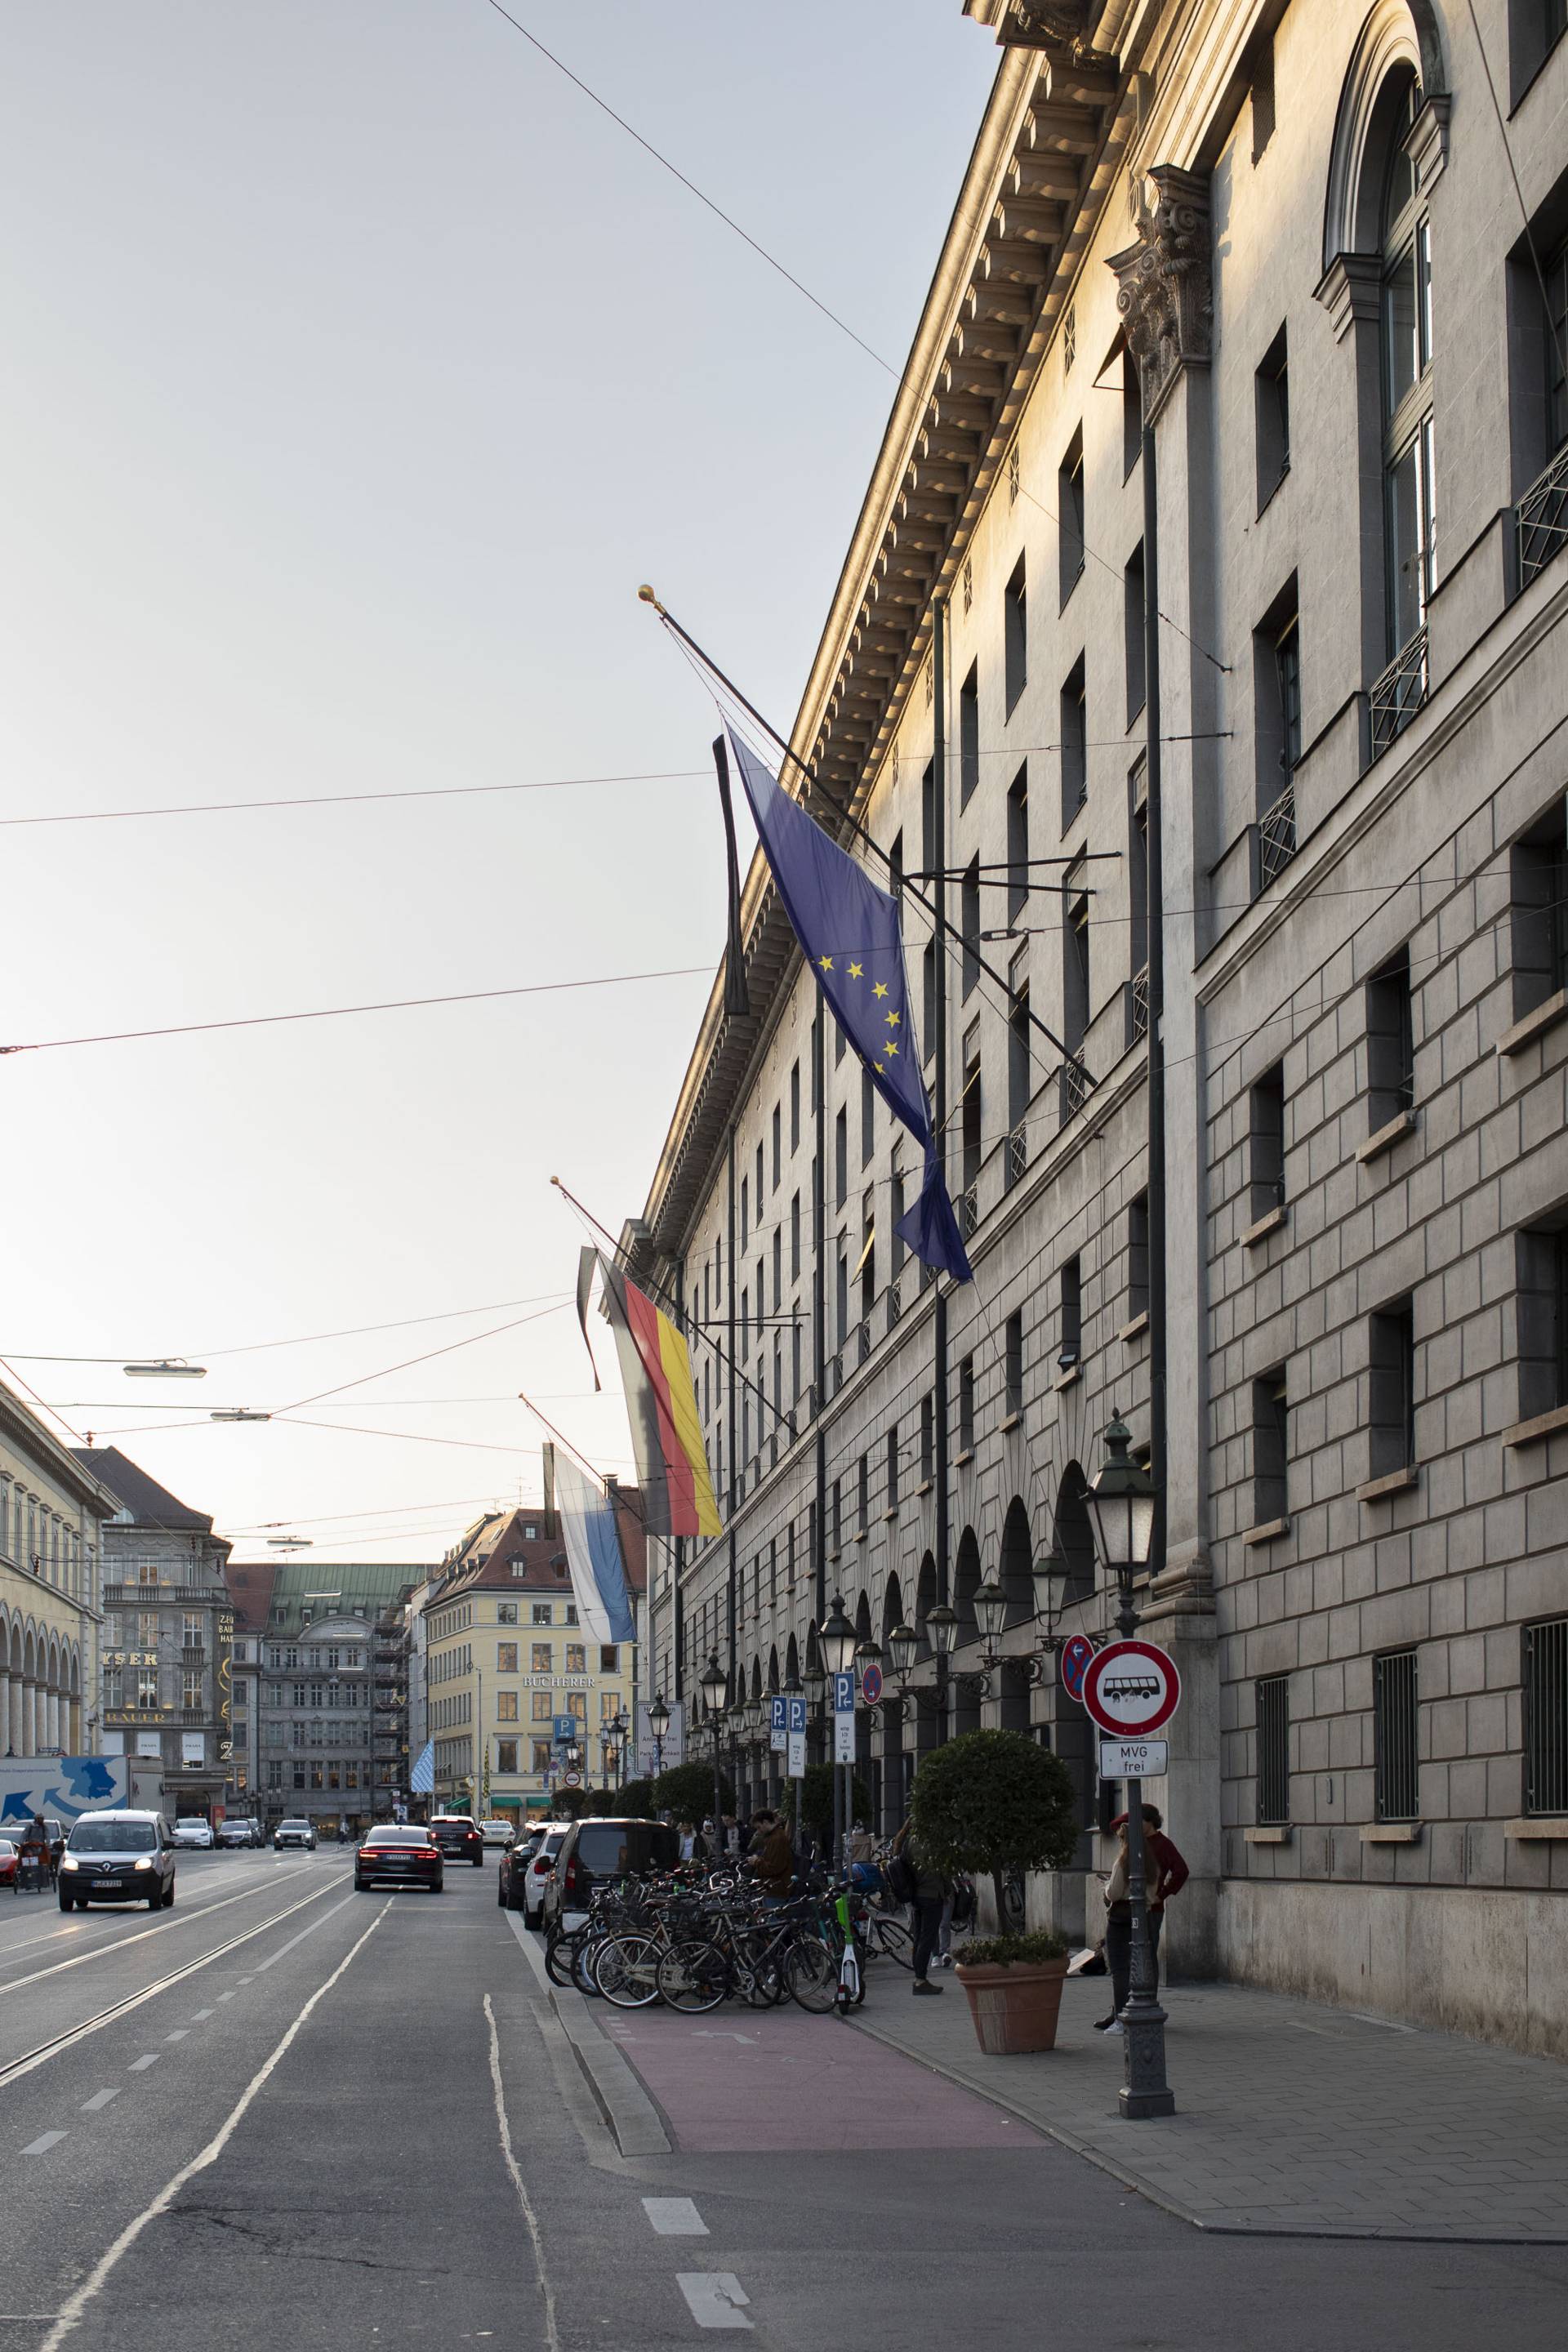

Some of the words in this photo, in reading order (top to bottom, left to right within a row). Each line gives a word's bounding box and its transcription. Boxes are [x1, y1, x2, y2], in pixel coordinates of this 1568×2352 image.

[523, 1676, 595, 1688] BUCHERER
[838, 1677, 849, 1708] P
[1120, 1746, 1148, 1758] MVG
[1124, 1760, 1145, 1772] frei
